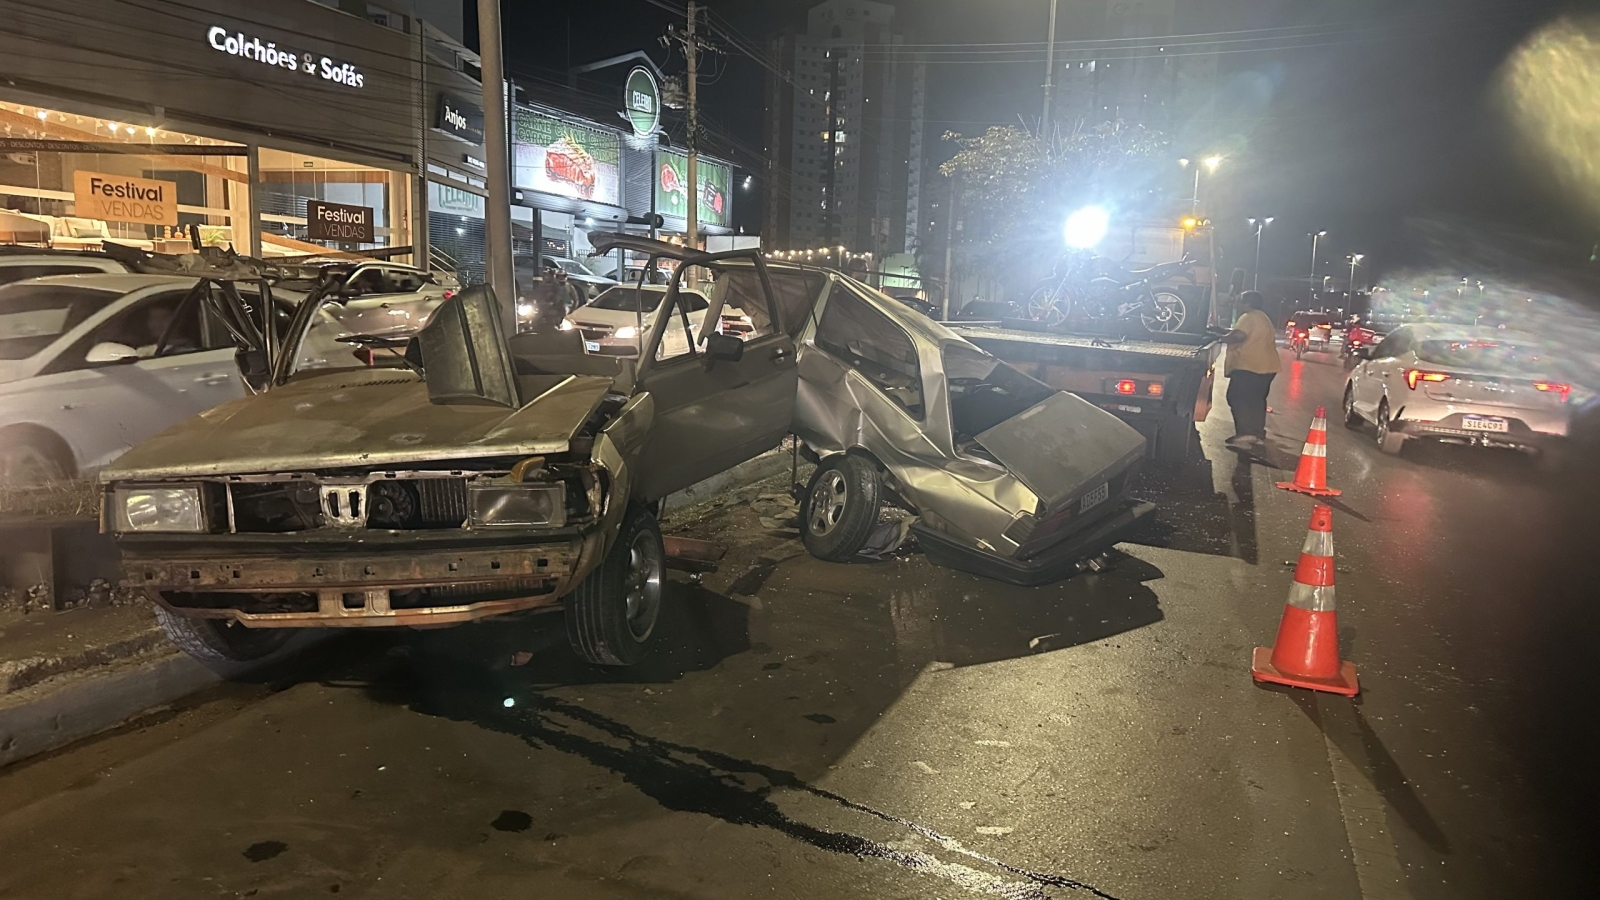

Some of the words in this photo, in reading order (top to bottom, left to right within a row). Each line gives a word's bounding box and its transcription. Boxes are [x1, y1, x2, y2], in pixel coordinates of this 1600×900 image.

[208, 26, 297, 70] Colchões
[302, 53, 316, 75] &
[320, 57, 364, 88] Sofás
[445, 105, 467, 130] Anjos
[517, 113, 551, 134] CARNE
[90, 177, 163, 202] Festival
[101, 200, 164, 220] VENDAS
[317, 206, 365, 224] Festival
[324, 223, 365, 239] VENDAS
